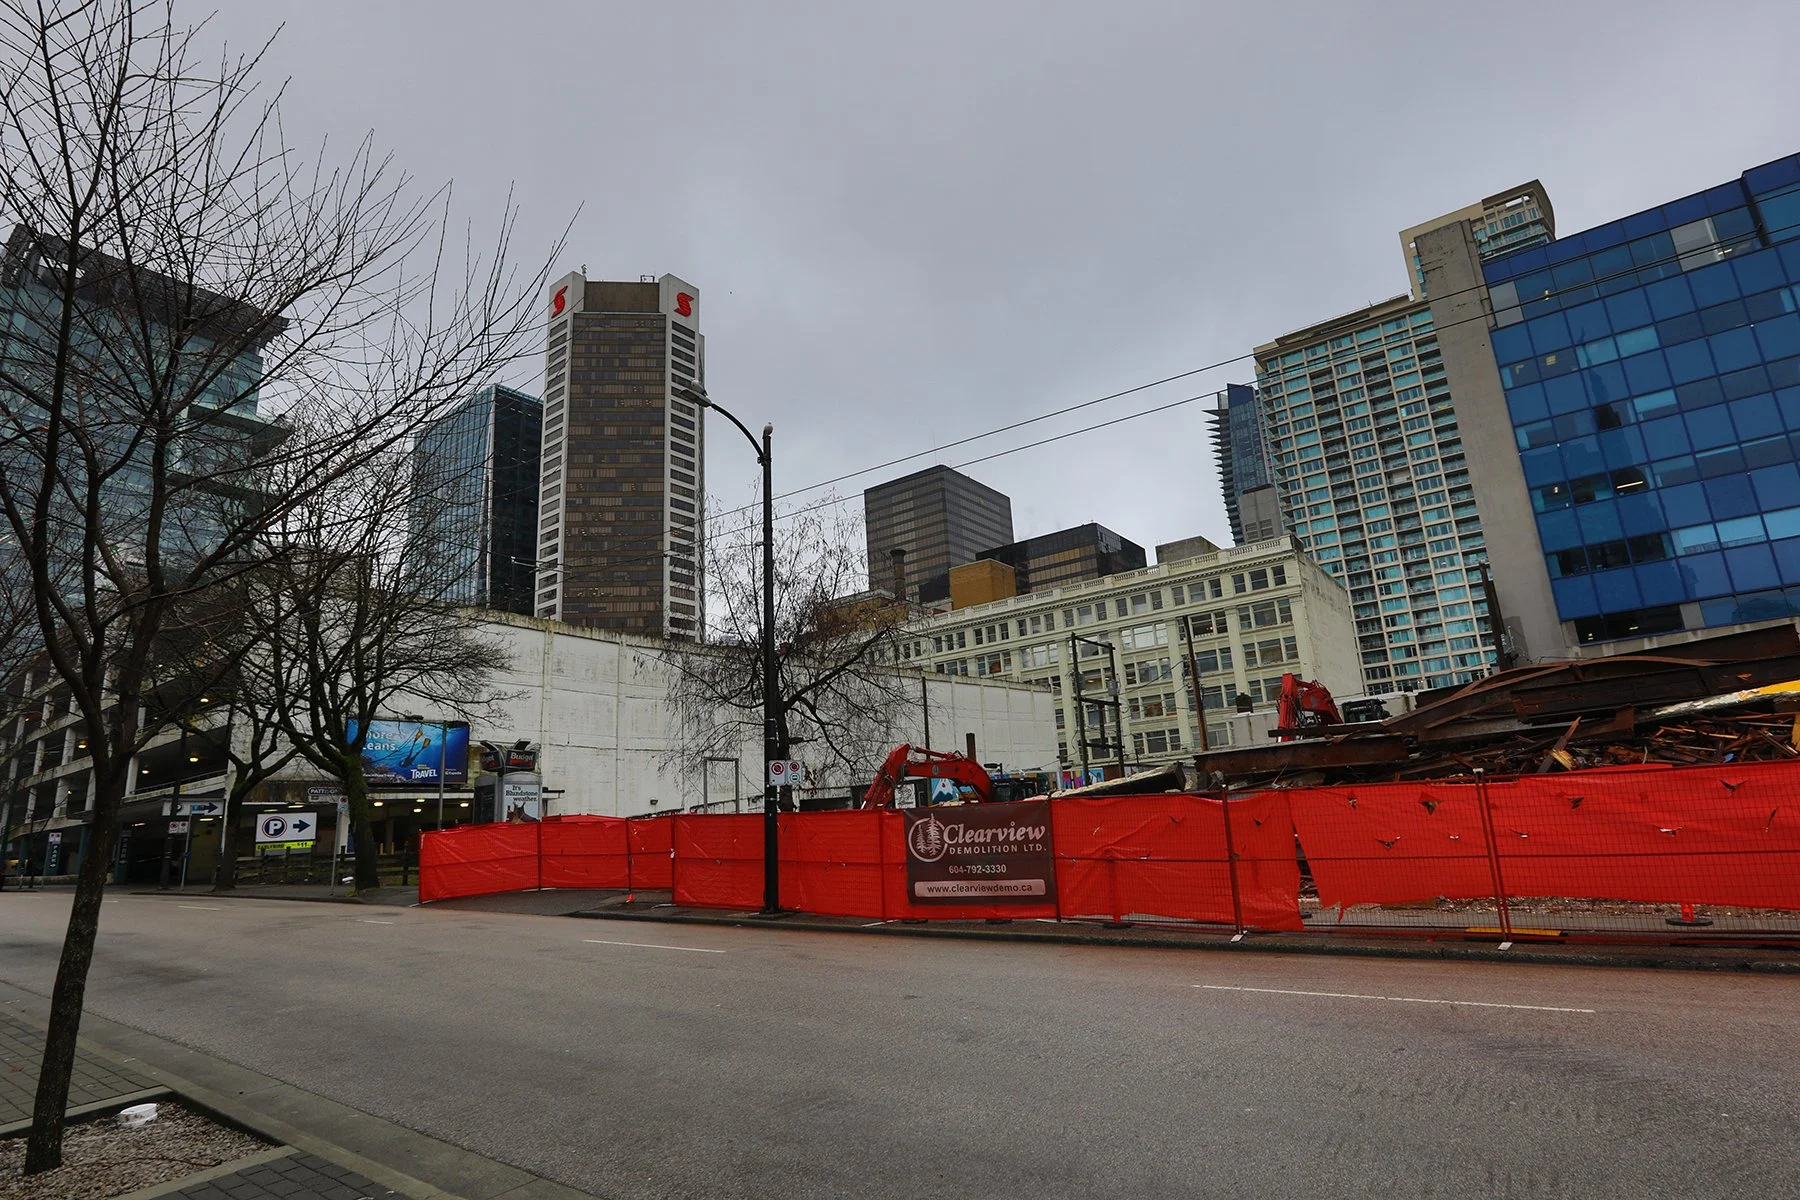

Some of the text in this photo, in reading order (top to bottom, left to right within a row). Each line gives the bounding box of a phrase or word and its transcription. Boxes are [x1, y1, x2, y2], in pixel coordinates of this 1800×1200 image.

[511, 752, 534, 761] Budget
[410, 768, 437, 779] TRAVEL
[268, 820, 283, 835] P
[943, 821, 1046, 844] Clearview
[51, 845, 59, 863] PARK
[949, 843, 1047, 855] DEMOLITION LTD.
[949, 864, 1007, 874] 604-792-3330
[927, 883, 1033, 894] www.clearviewdemo.ca
